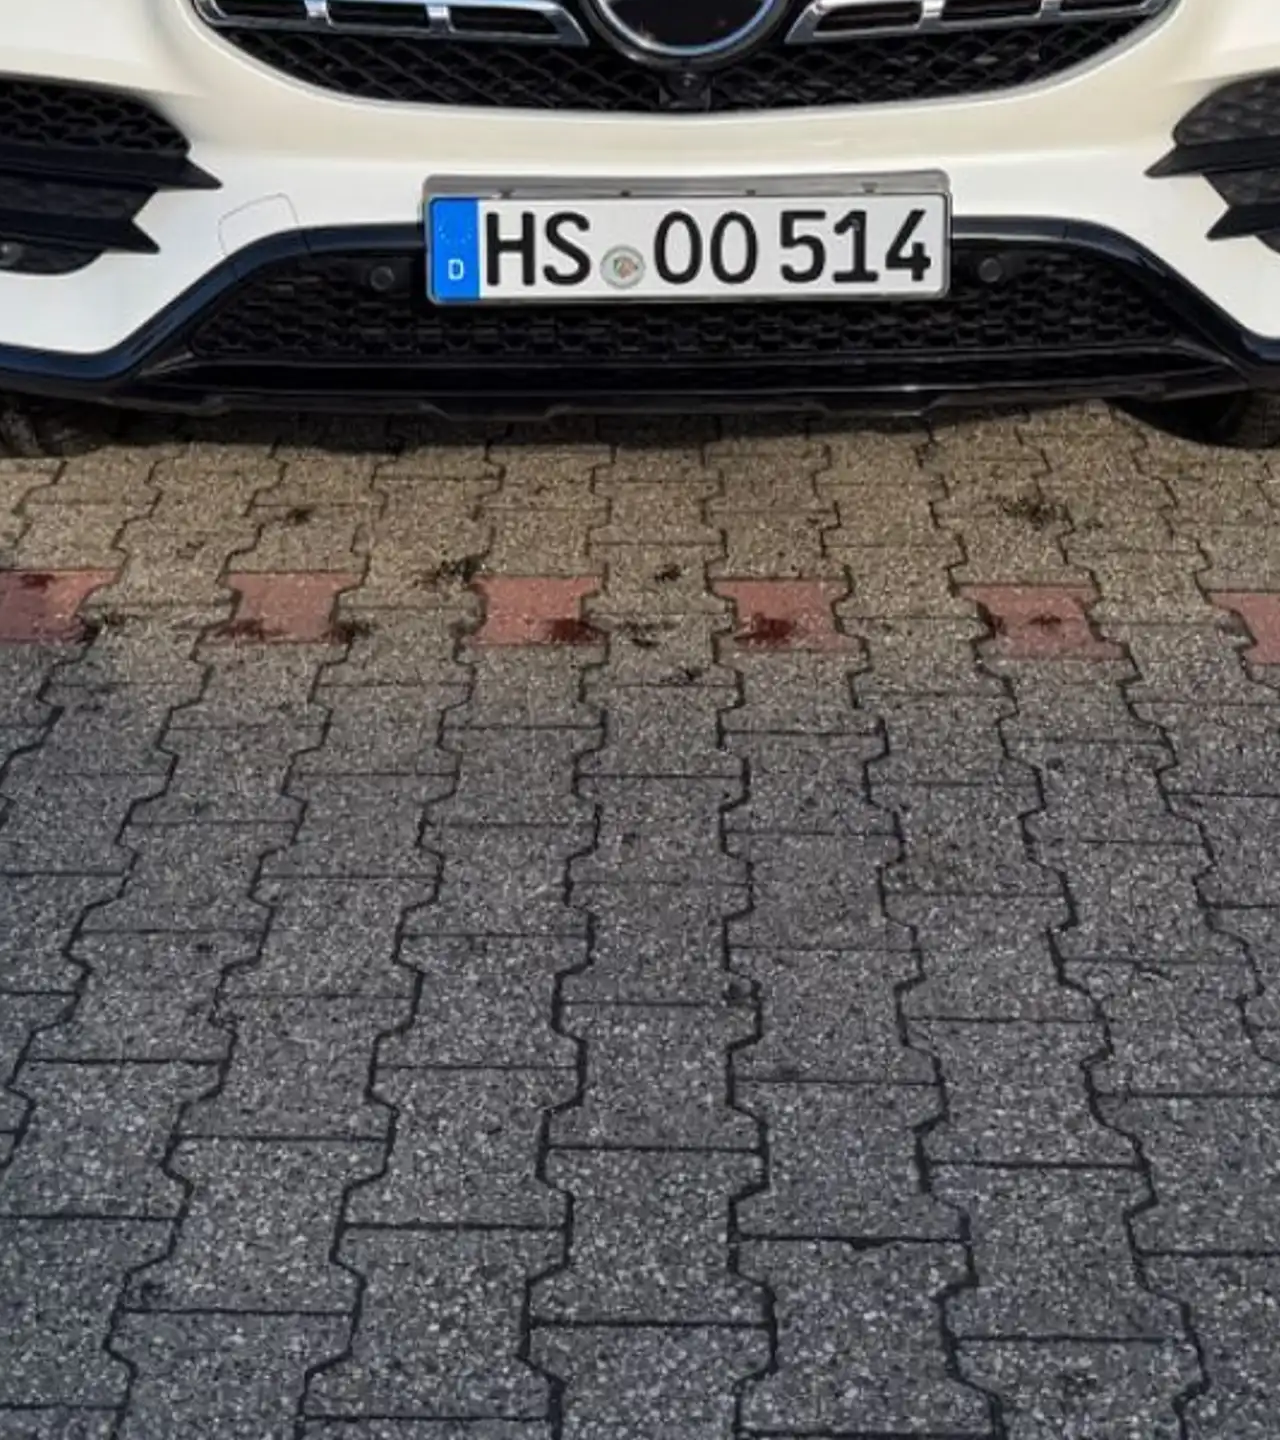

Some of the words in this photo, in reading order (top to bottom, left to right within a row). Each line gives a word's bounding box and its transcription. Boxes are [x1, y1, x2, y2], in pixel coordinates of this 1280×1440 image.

[447, 260, 465, 281] D
[485, 211, 592, 287] HS
[780, 209, 933, 282] 514
